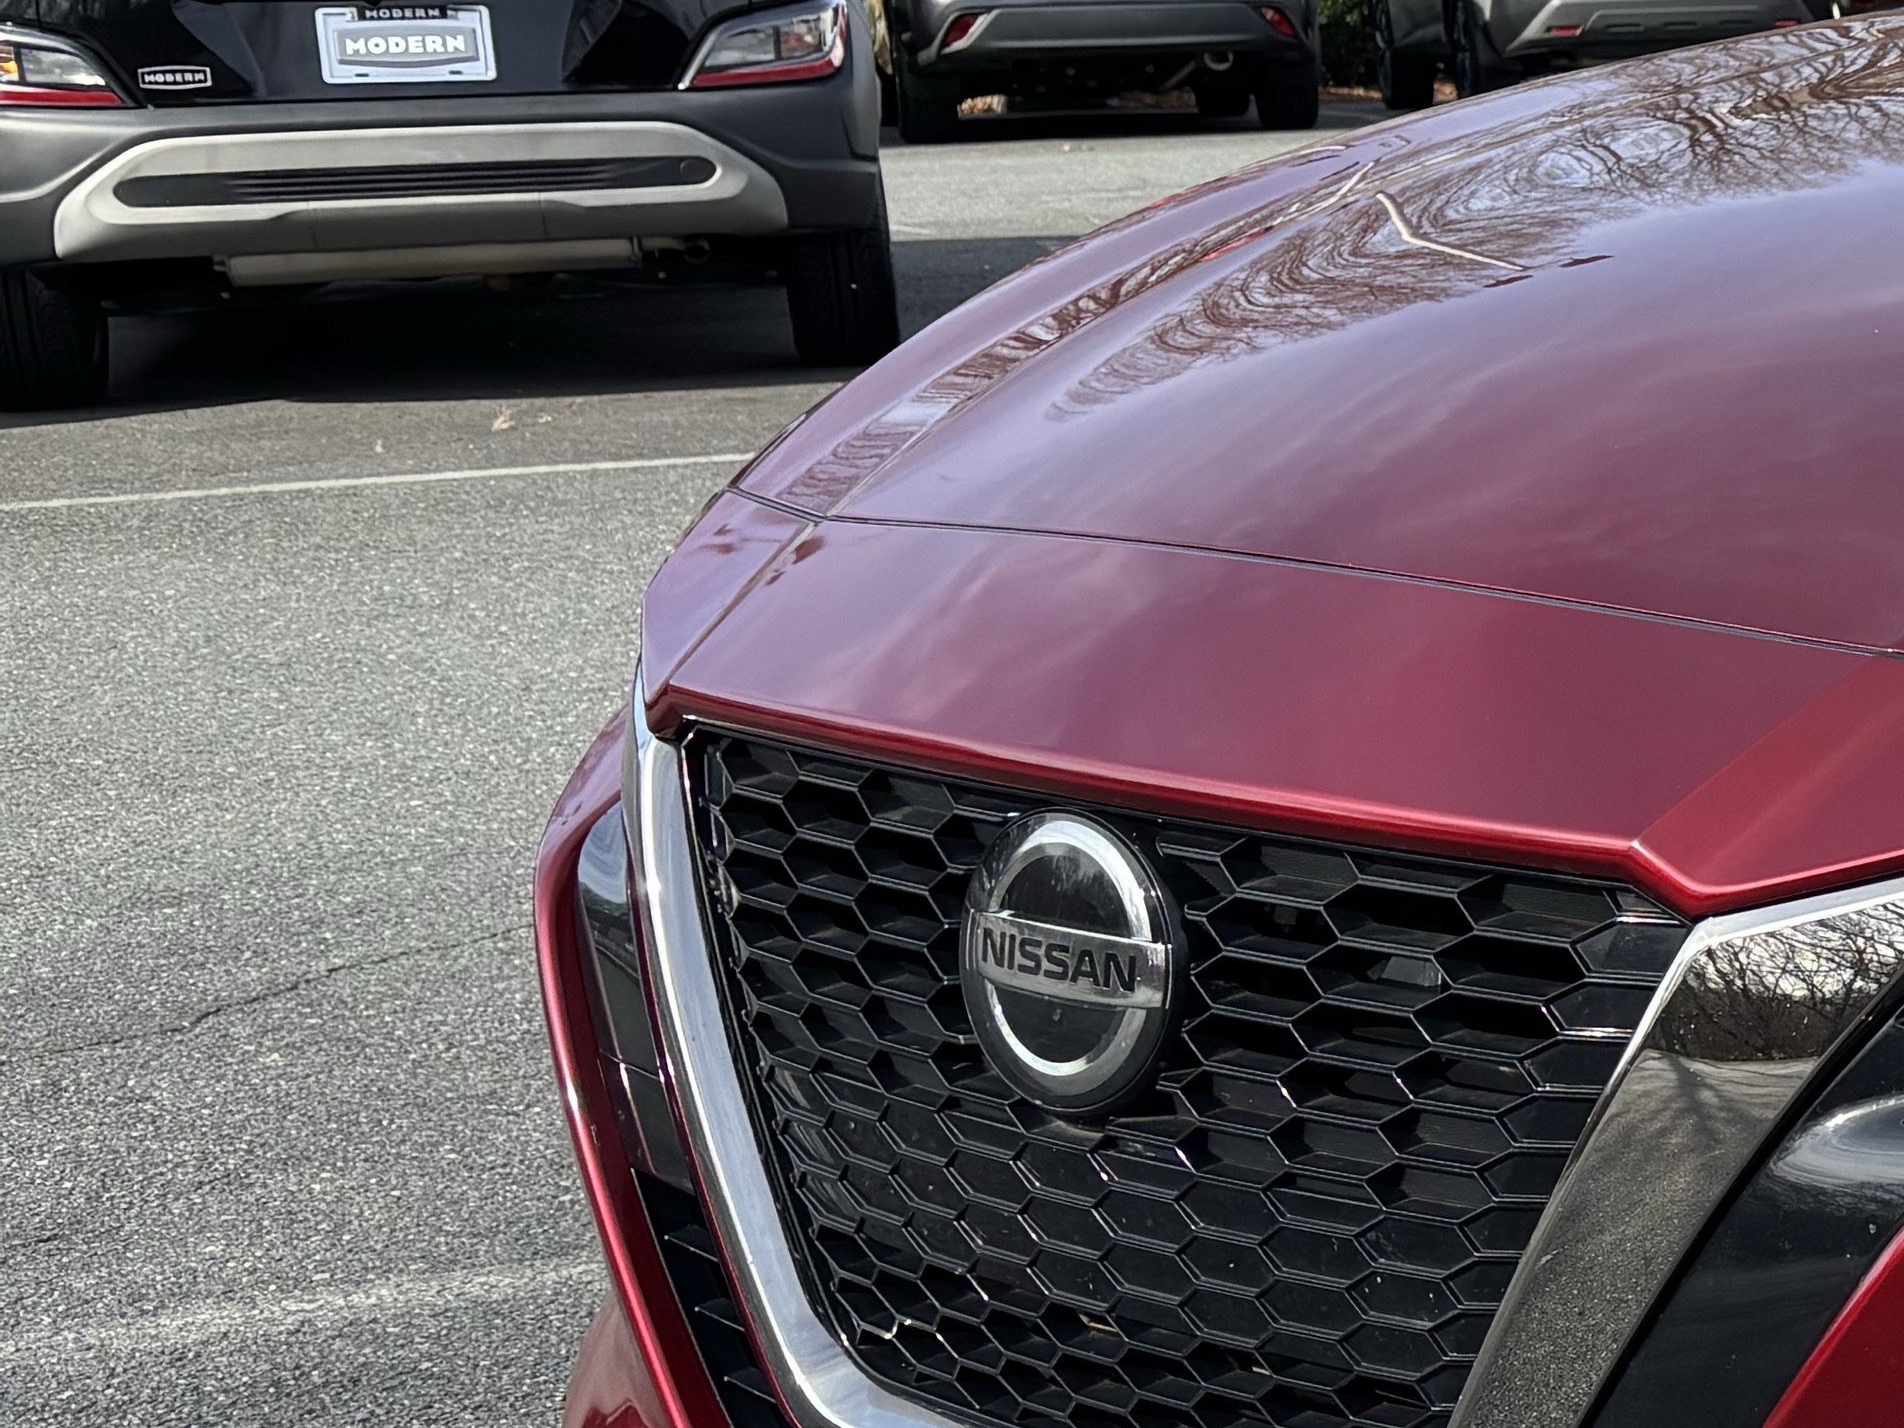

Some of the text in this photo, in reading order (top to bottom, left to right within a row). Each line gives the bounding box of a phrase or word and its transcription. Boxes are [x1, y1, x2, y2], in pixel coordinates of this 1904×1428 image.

[344, 34, 466, 56] MODERN
[144, 72, 205, 84] MODERN
[980, 926, 1138, 994] NISSAN
